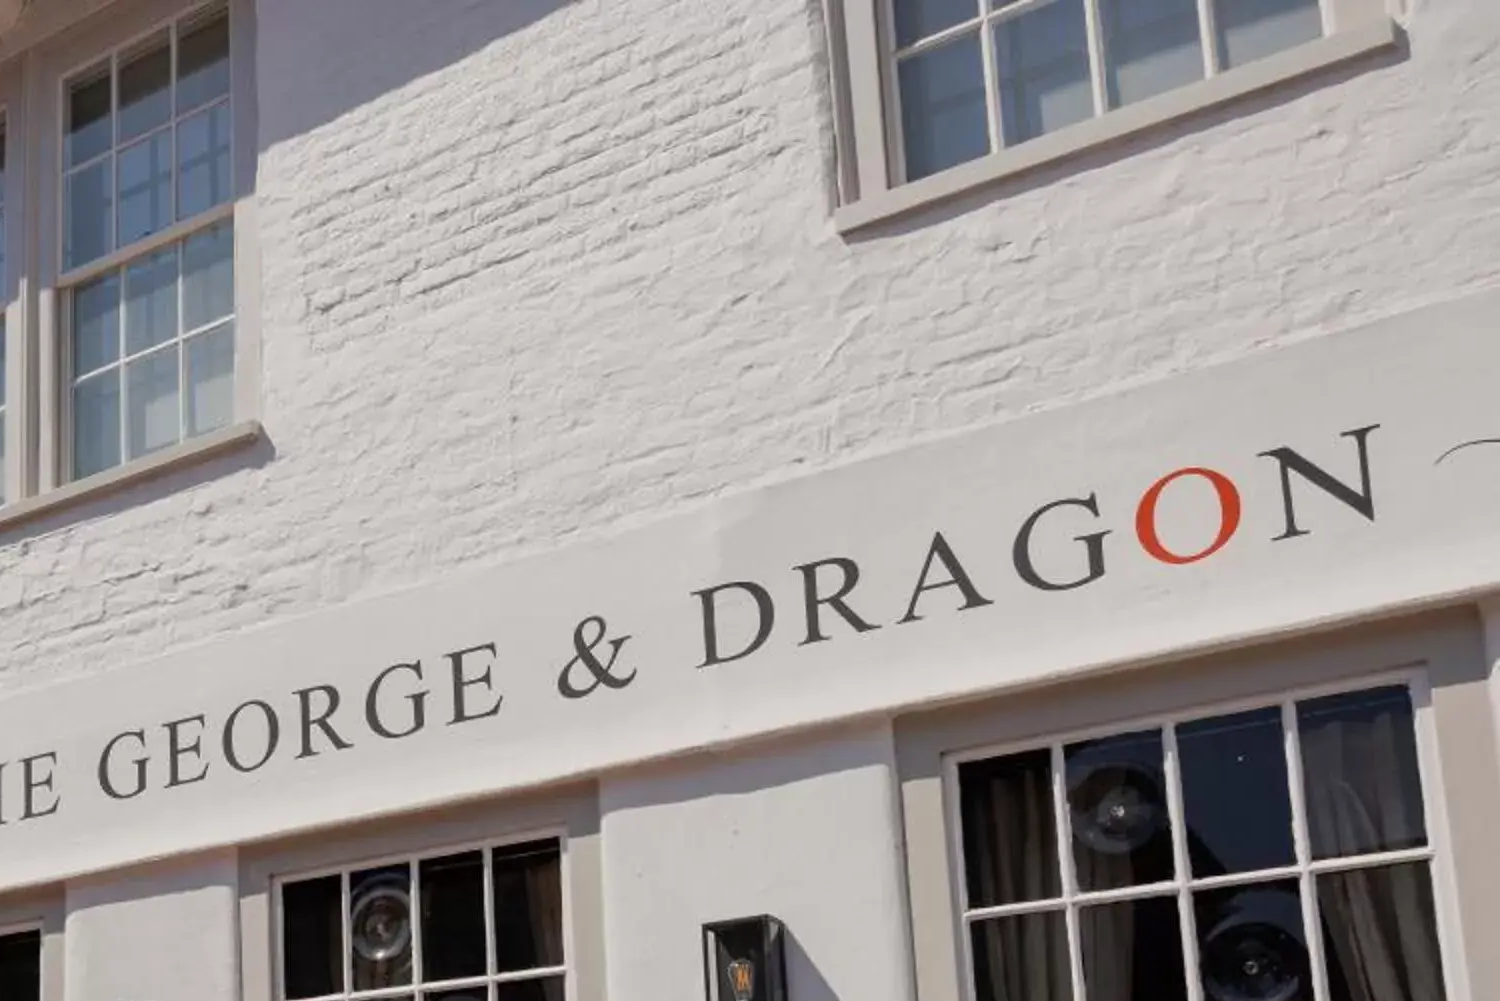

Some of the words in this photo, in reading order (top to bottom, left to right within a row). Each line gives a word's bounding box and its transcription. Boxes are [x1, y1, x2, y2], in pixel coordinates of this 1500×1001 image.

[97, 642, 504, 800] GEORGE
[556, 615, 638, 700] &
[690, 423, 1382, 668] DRAGON
